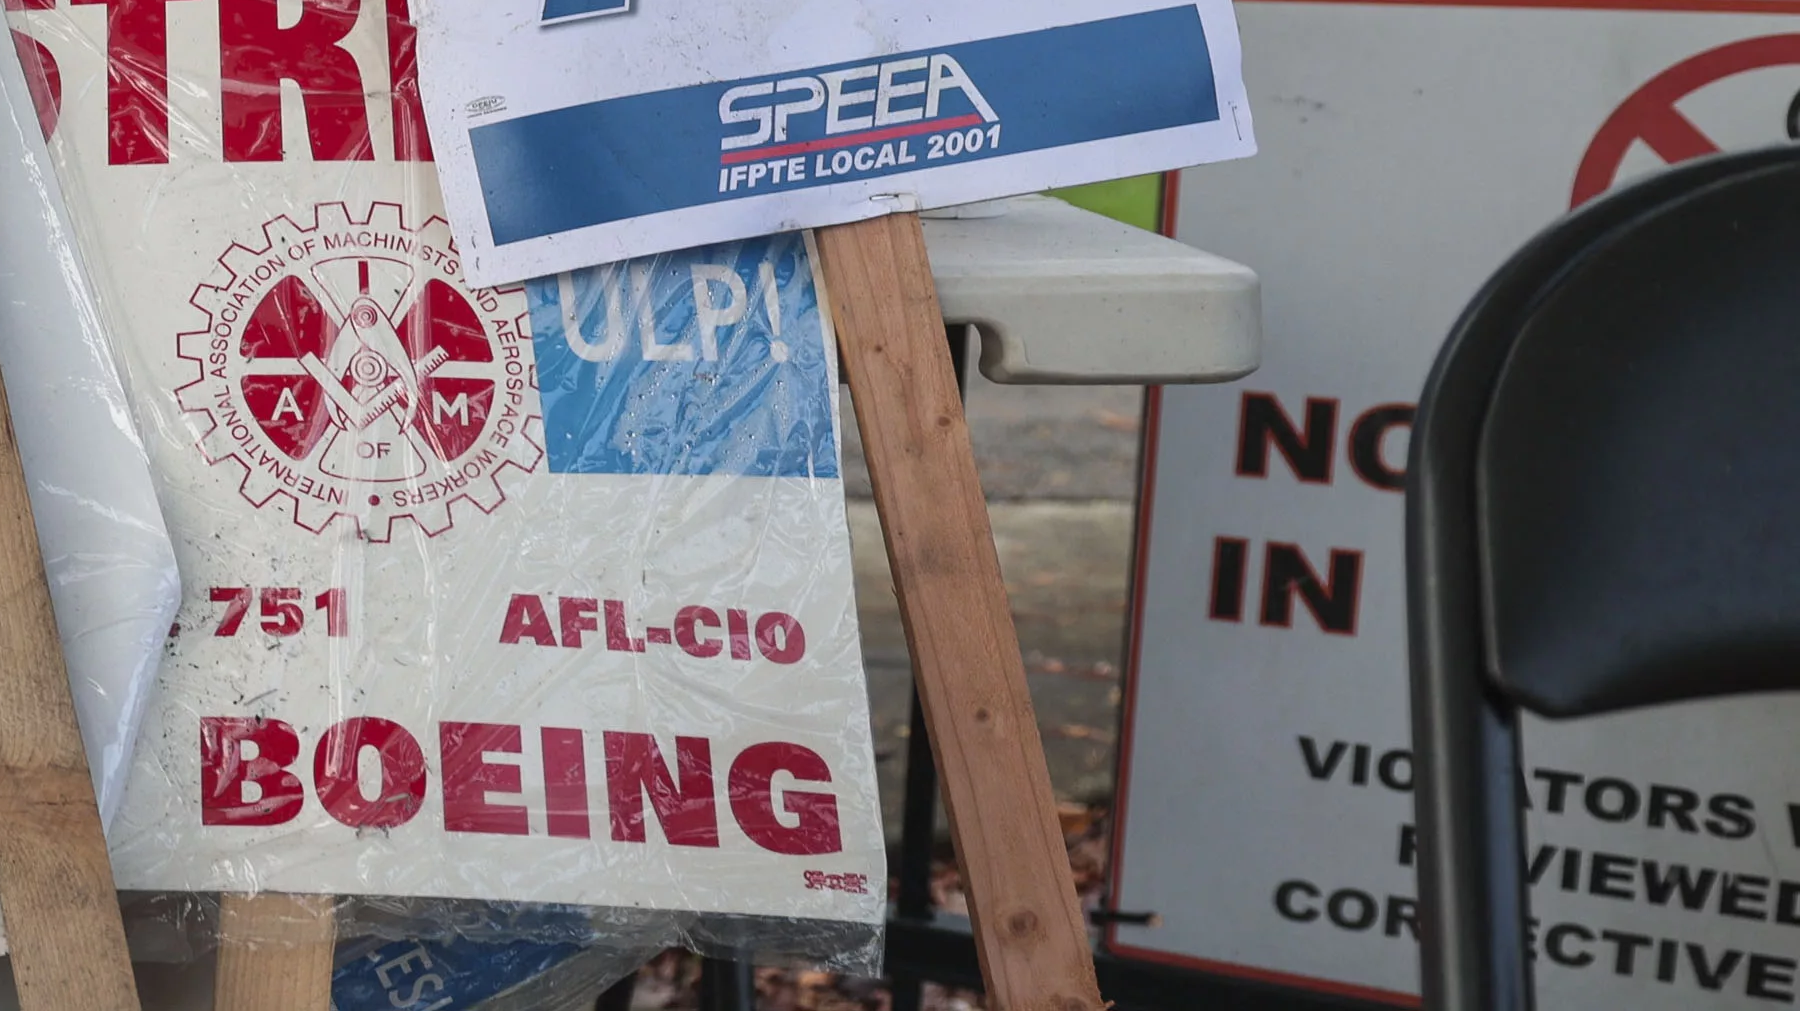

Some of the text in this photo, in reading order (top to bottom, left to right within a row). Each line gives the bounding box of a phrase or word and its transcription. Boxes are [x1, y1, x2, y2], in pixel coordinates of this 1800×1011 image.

[719, 53, 1000, 151] SPEEA
[718, 122, 1000, 194] IFPTE LOCAL 2001
[288, 239, 317, 261] OF
[210, 254, 287, 380] ASSOCIATION
[557, 262, 790, 364] ULP!
[490, 318, 524, 449] AEROSPACE
[356, 441, 392, 460] OF
[393, 448, 499, 508] WORKERS
[209, 588, 807, 665] 751 AFL-CIO
[1208, 535, 1364, 636] IN
[200, 716, 844, 856] BOEING
[1297, 734, 1756, 840] VIOTORS
